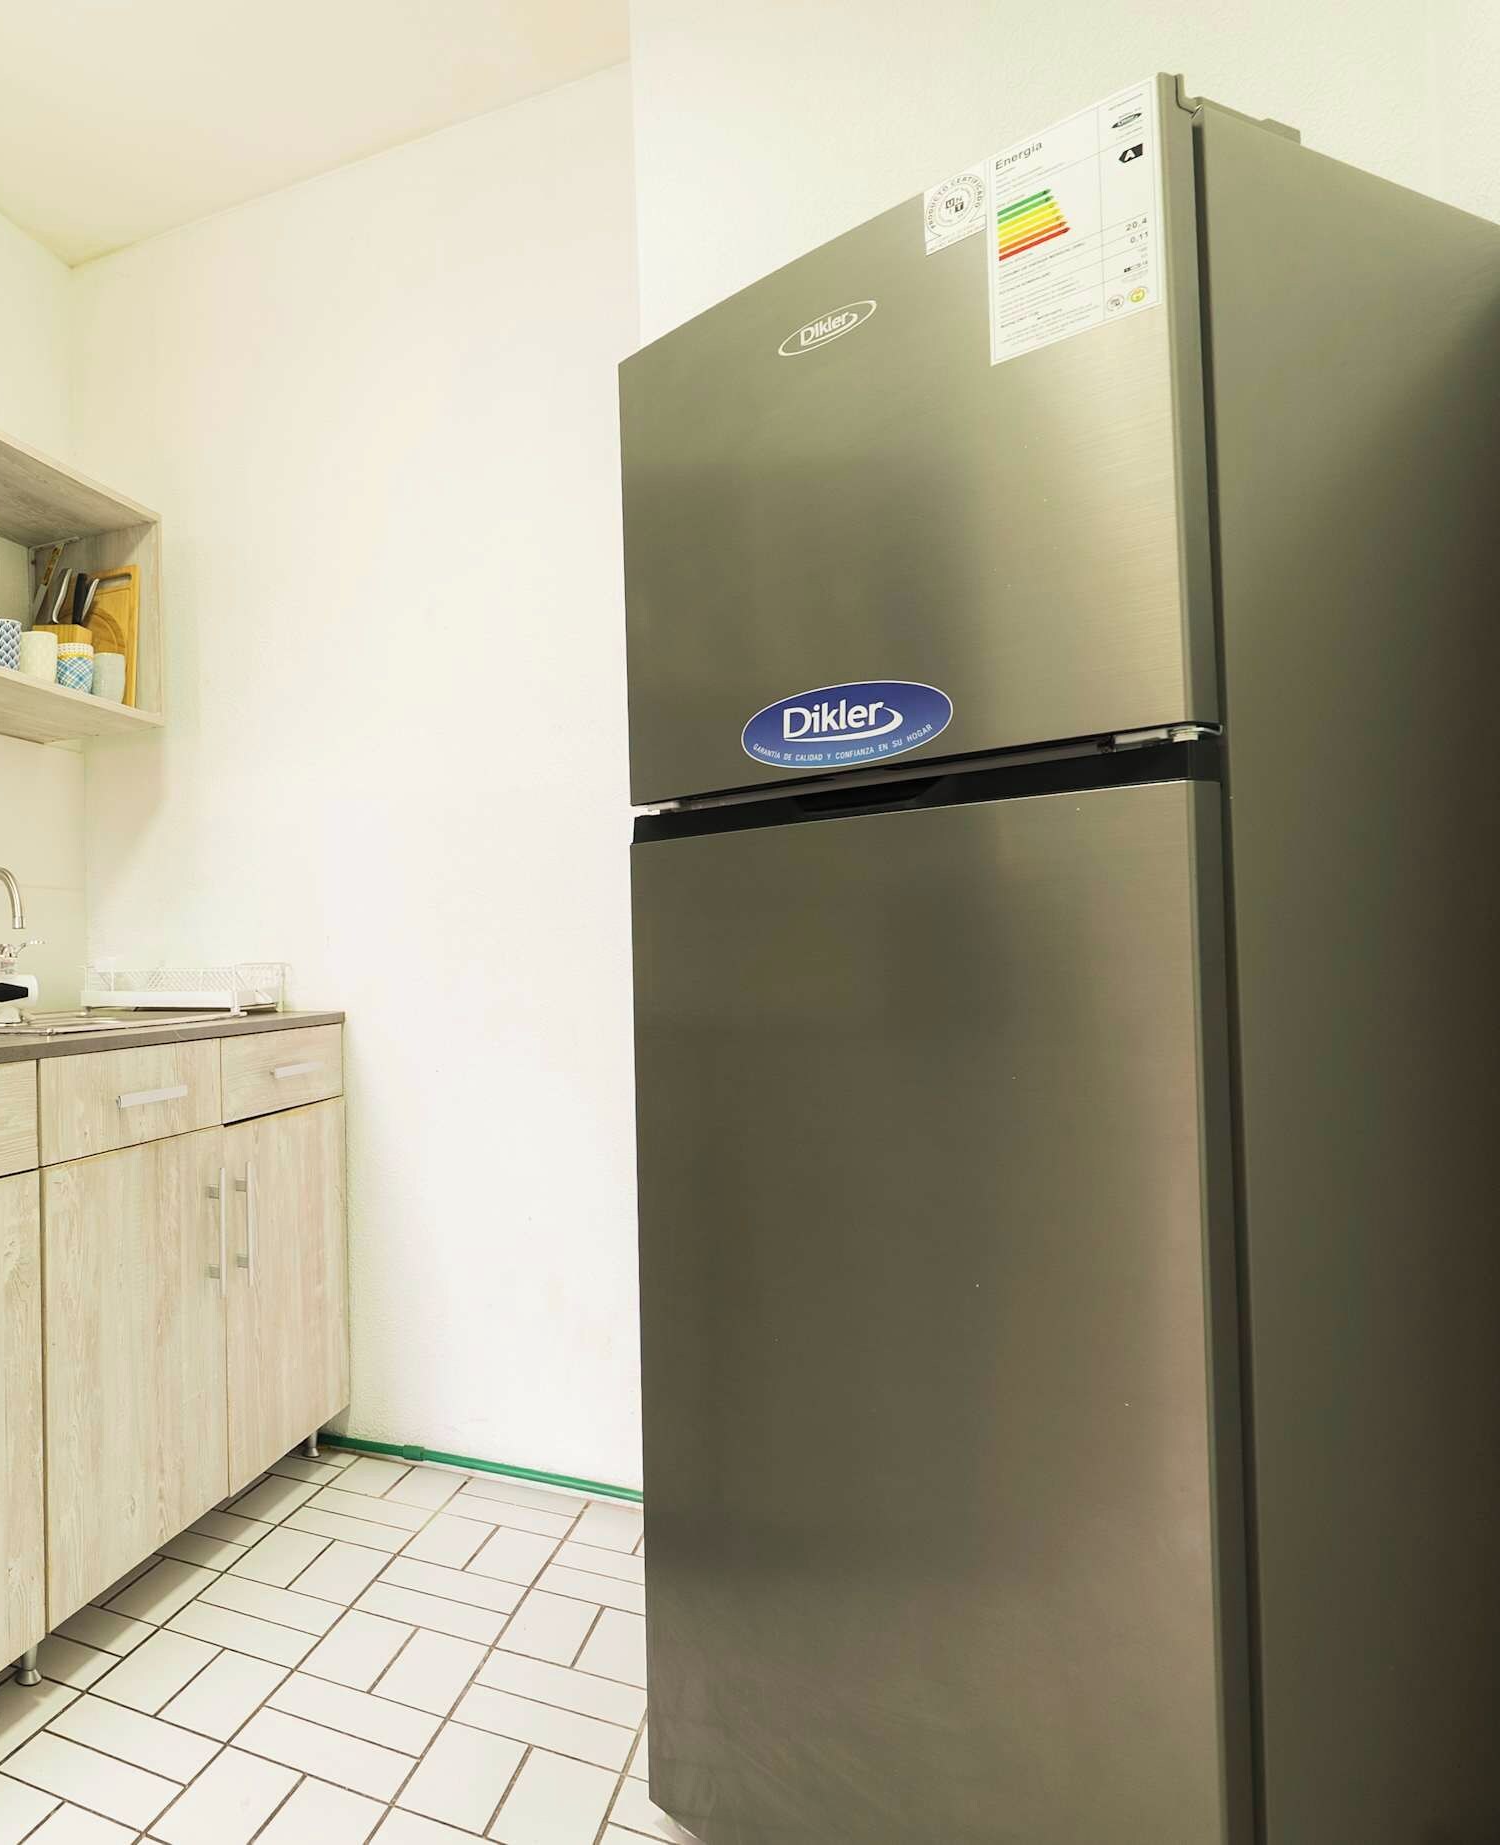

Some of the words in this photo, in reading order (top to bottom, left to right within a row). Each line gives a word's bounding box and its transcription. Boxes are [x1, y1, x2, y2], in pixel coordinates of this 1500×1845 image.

[1124, 149, 1136, 162] A
[800, 312, 850, 346] Dikler
[783, 699, 885, 739] Dikler
[783, 752, 792, 761] DE
[795, 753, 824, 762] CALIDAD
[826, 752, 832, 760] Y
[835, 746, 875, 760] CONFIANZA
[878, 743, 889, 752] EN
[892, 738, 903, 748] SU
[906, 723, 933, 743] HOGAR
